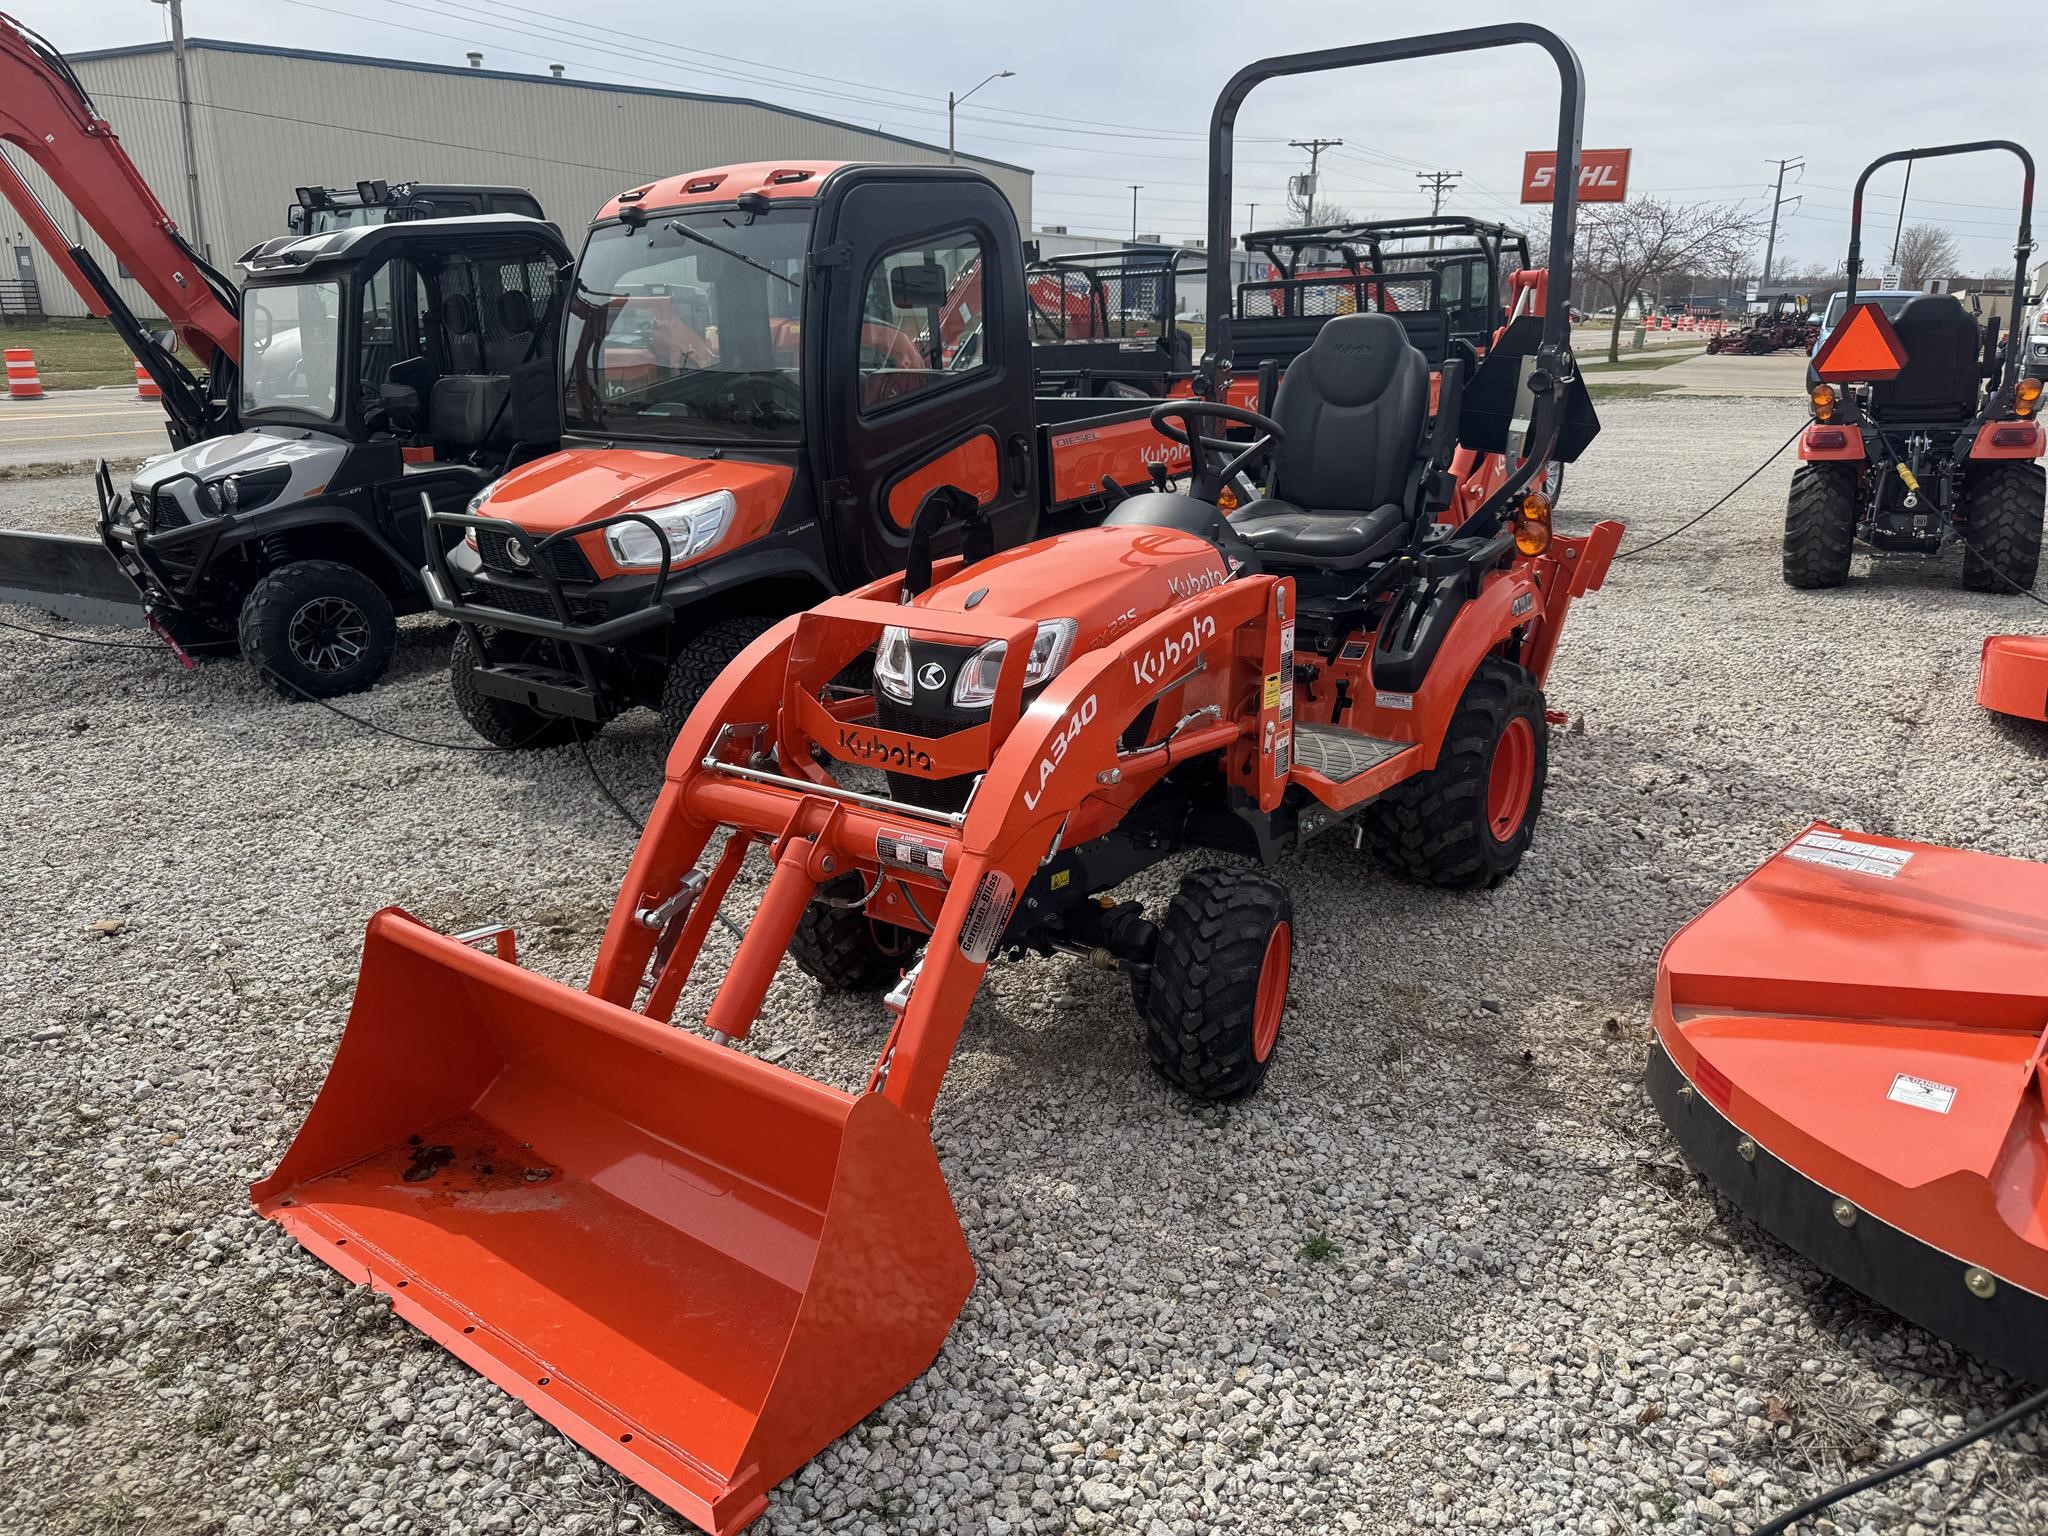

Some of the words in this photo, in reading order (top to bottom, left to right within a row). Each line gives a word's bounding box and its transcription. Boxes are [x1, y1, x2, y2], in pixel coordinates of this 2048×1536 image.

[1529, 165, 1619, 188] SHL
[1056, 433, 1100, 447] DIESEL
[1168, 567, 1223, 598] Kubota
[1133, 615, 1216, 685] Kubota
[840, 728, 931, 771] Kubota
[1023, 693, 1097, 811] LA340
[904, 835, 923, 844] DANGER
[962, 873, 998, 952] German-Bliss
